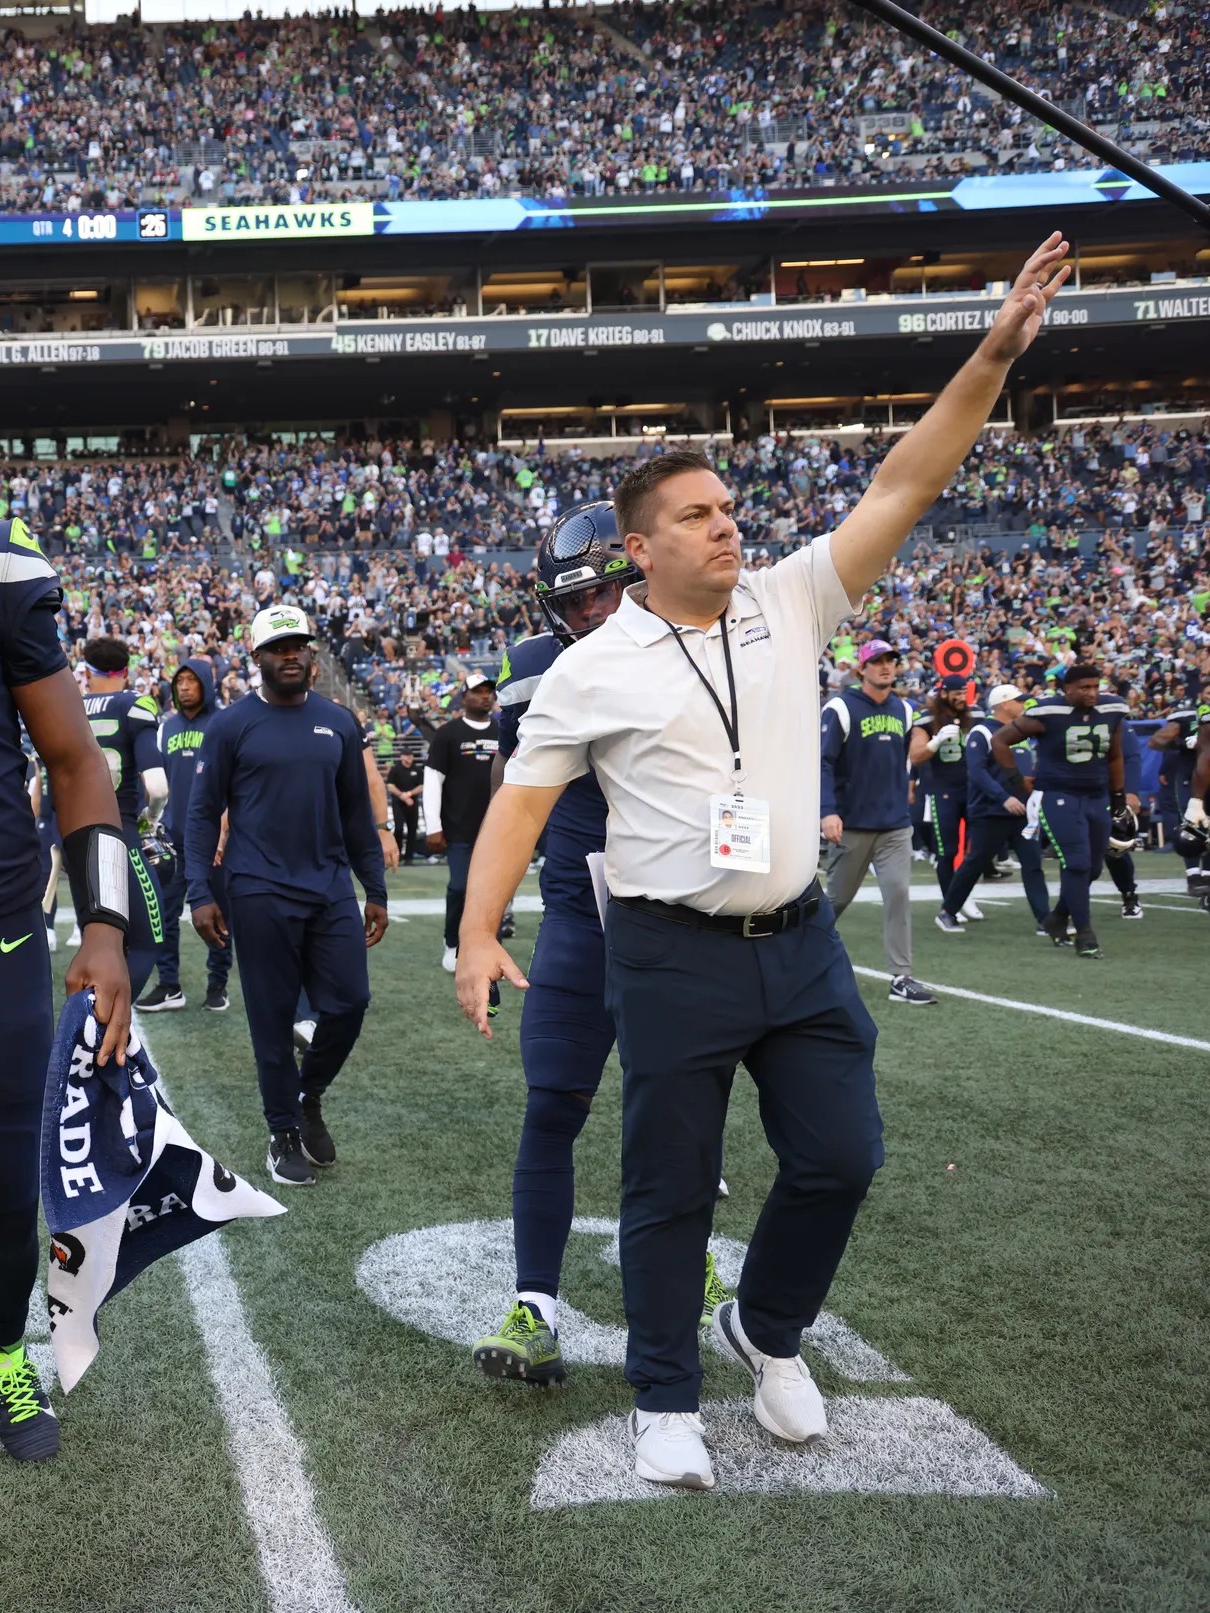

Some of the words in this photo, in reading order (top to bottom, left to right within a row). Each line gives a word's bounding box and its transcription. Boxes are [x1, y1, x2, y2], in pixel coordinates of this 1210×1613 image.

[62, 219, 72, 238] 4
[77, 215, 117, 239] 0:00
[204, 211, 352, 232] SEAHAWKS
[1053, 309, 1088, 325] 90-00
[1134, 301, 1158, 320] 71
[1158, 297, 1210, 318] WALTE
[732, 322, 780, 341] CHUCK
[783, 319, 823, 339] KNOX
[899, 314, 925, 333] 96
[926, 310, 982, 332] CORTEZ
[331, 333, 356, 353] 45
[357, 333, 403, 352] KENNY
[405, 332, 455, 351] EASLEY
[528, 329, 549, 347] 17
[550, 328, 586, 346] DAVE
[588, 326, 632, 345] KRIEG
[27, 344, 69, 363] ALLEN
[142, 341, 165, 359] 79
[166, 340, 209, 358] JACOB
[212, 339, 256, 357] GREEN
